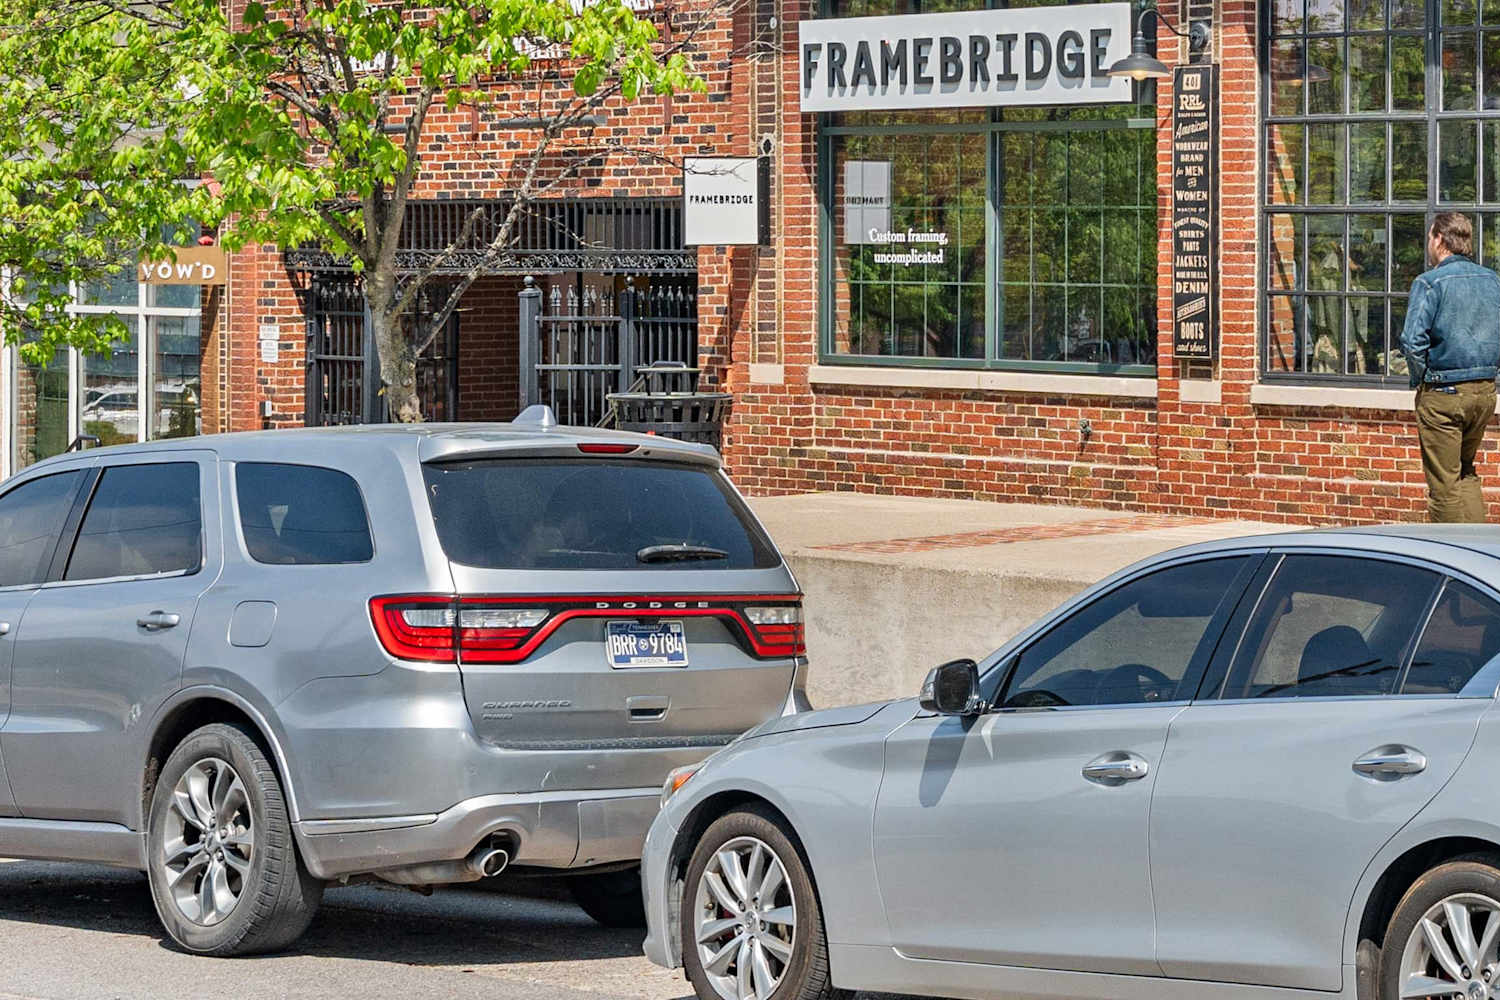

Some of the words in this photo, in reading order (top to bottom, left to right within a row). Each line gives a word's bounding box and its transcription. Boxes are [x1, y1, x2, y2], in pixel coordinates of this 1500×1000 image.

[803, 28, 1113, 89] FRAMEBRIDGE
[1179, 94, 1206, 111] RRL
[1180, 153, 1204, 162] BRAND
[1185, 165, 1204, 177] MEN
[689, 194, 753, 205] FRAMEBRIDGE
[1175, 190, 1208, 201] WOMEN
[869, 228, 905, 242] Custom
[907, 228, 948, 245] framing,
[1178, 230, 1205, 238] SHIRTS
[1182, 241, 1200, 252] PANTS
[874, 248, 944, 267] uncomplicated
[1175, 254, 1208, 268] JACKETS
[1175, 281, 1208, 294] DENIM
[1180, 322, 1204, 340] BOOTS
[596, 601, 709, 609] DODGE
[612, 633, 638, 656] BRR
[649, 632, 682, 655] 9784
